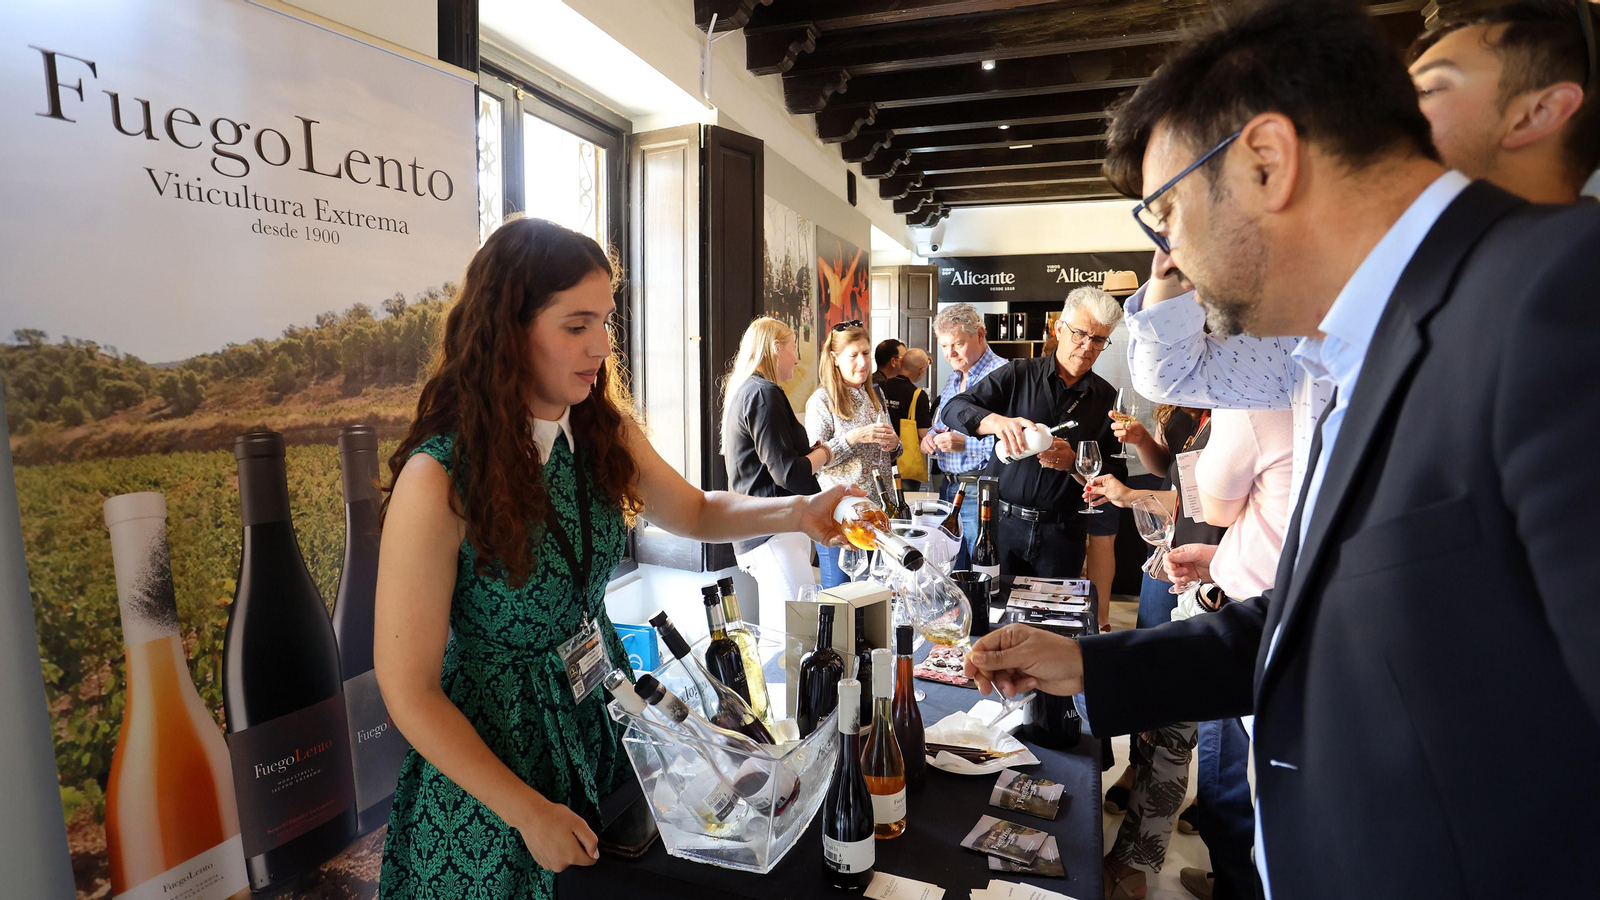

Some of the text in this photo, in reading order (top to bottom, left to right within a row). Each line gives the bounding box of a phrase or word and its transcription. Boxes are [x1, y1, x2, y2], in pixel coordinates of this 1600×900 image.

[28, 44, 455, 202] FuegoLento
[143, 167, 410, 236] Viticultura Extrema
[251, 219, 341, 246] desde 1900
[951, 270, 1016, 286] Alicante
[1056, 267, 1122, 283] Alican
[253, 739, 333, 780] FuegoLento
[163, 863, 214, 893] FuegoLento
